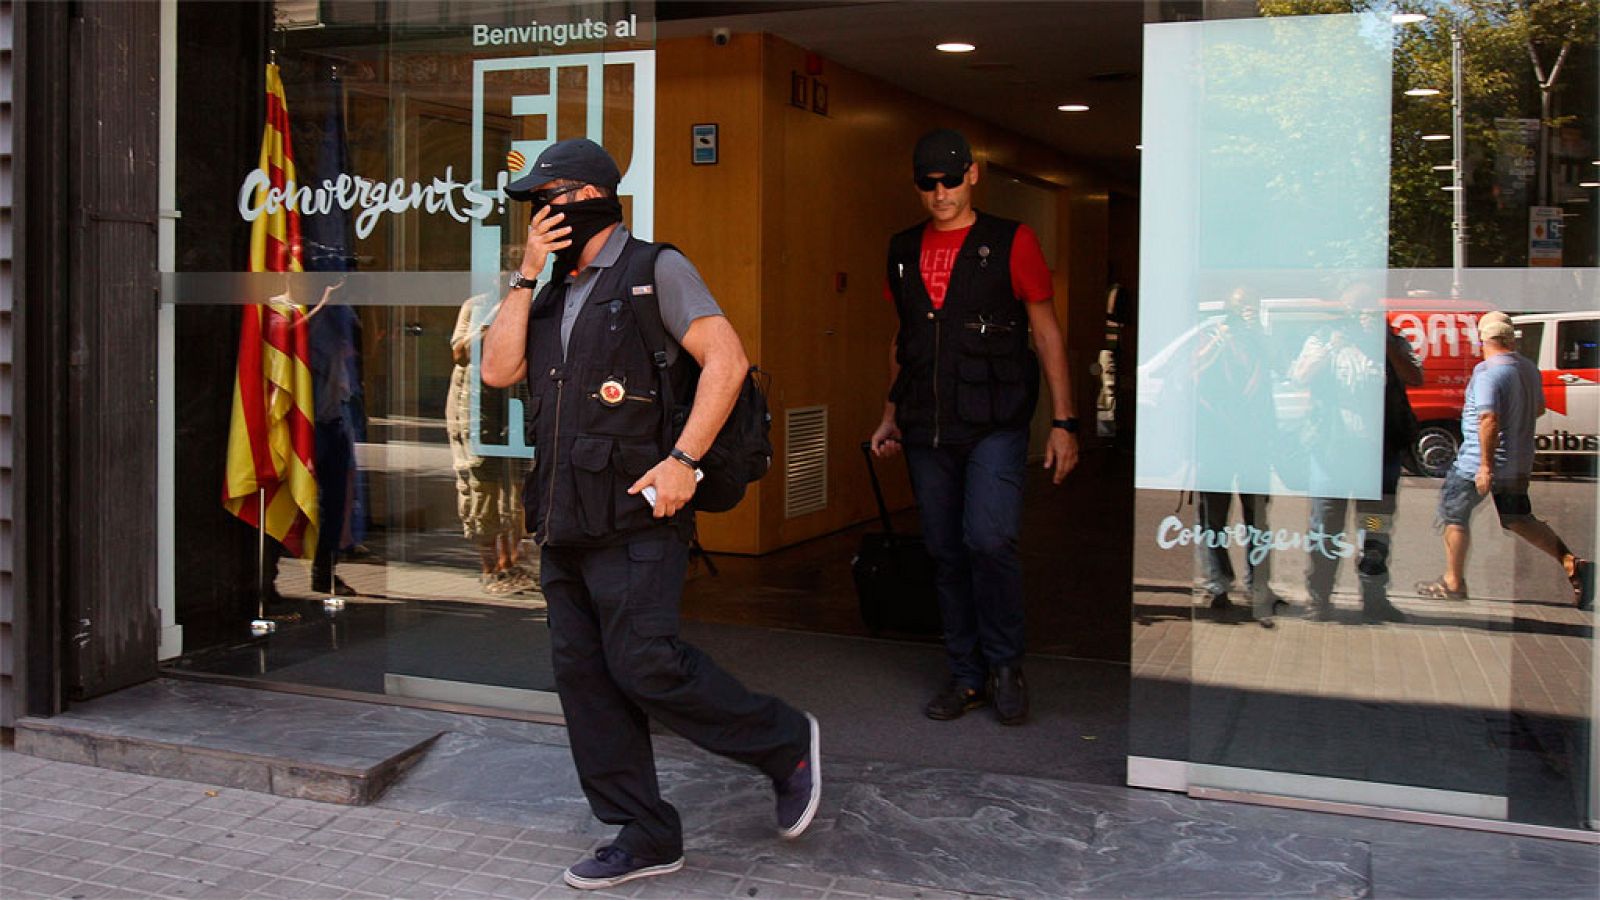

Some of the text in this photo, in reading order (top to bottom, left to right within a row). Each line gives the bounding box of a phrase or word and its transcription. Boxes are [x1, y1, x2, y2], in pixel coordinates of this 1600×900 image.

[472, 13, 637, 46] Benvinguts al
[239, 165, 509, 240] Convergents!
[1156, 515, 1367, 567] Convergents!
